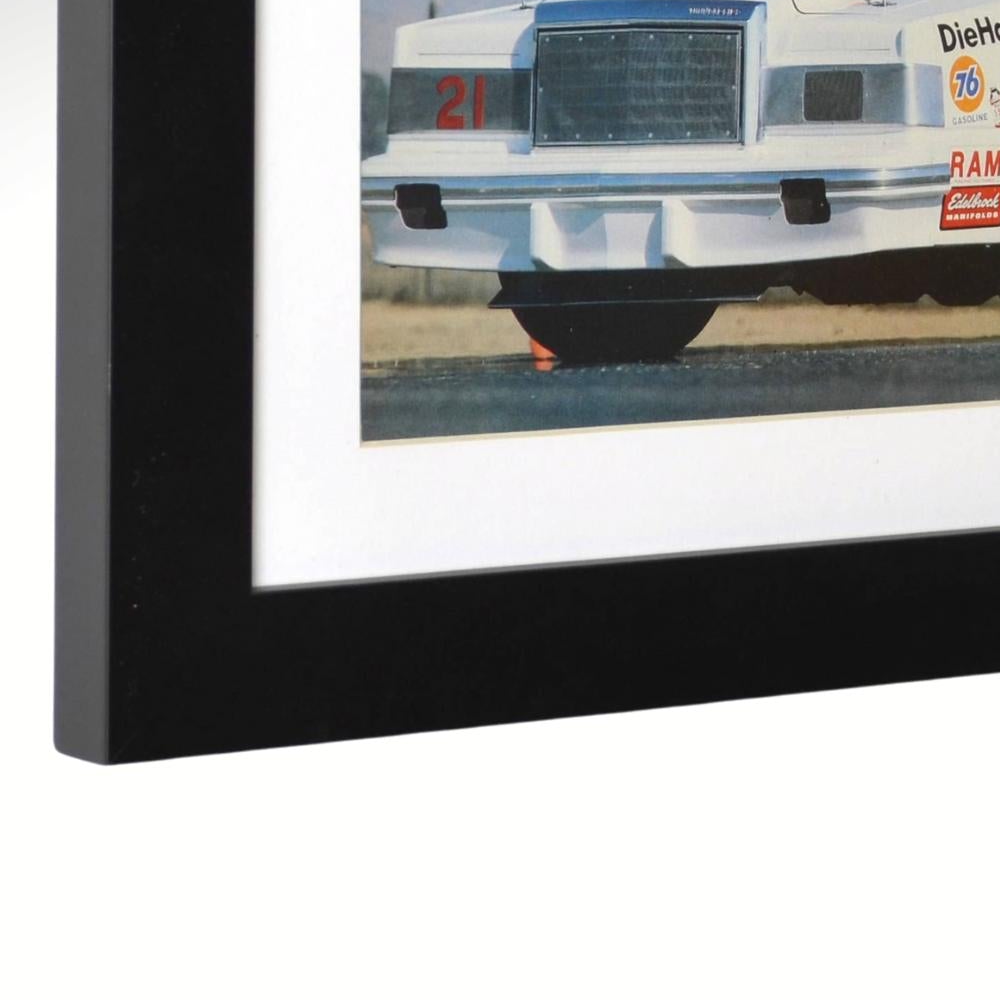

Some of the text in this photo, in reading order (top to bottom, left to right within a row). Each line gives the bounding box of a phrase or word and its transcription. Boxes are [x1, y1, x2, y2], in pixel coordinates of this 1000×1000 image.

[954, 65, 980, 99] 76
[436, 74, 485, 130] 21
[952, 112, 989, 126] GASOLINE
[947, 191, 1000, 211] Edelbrock
